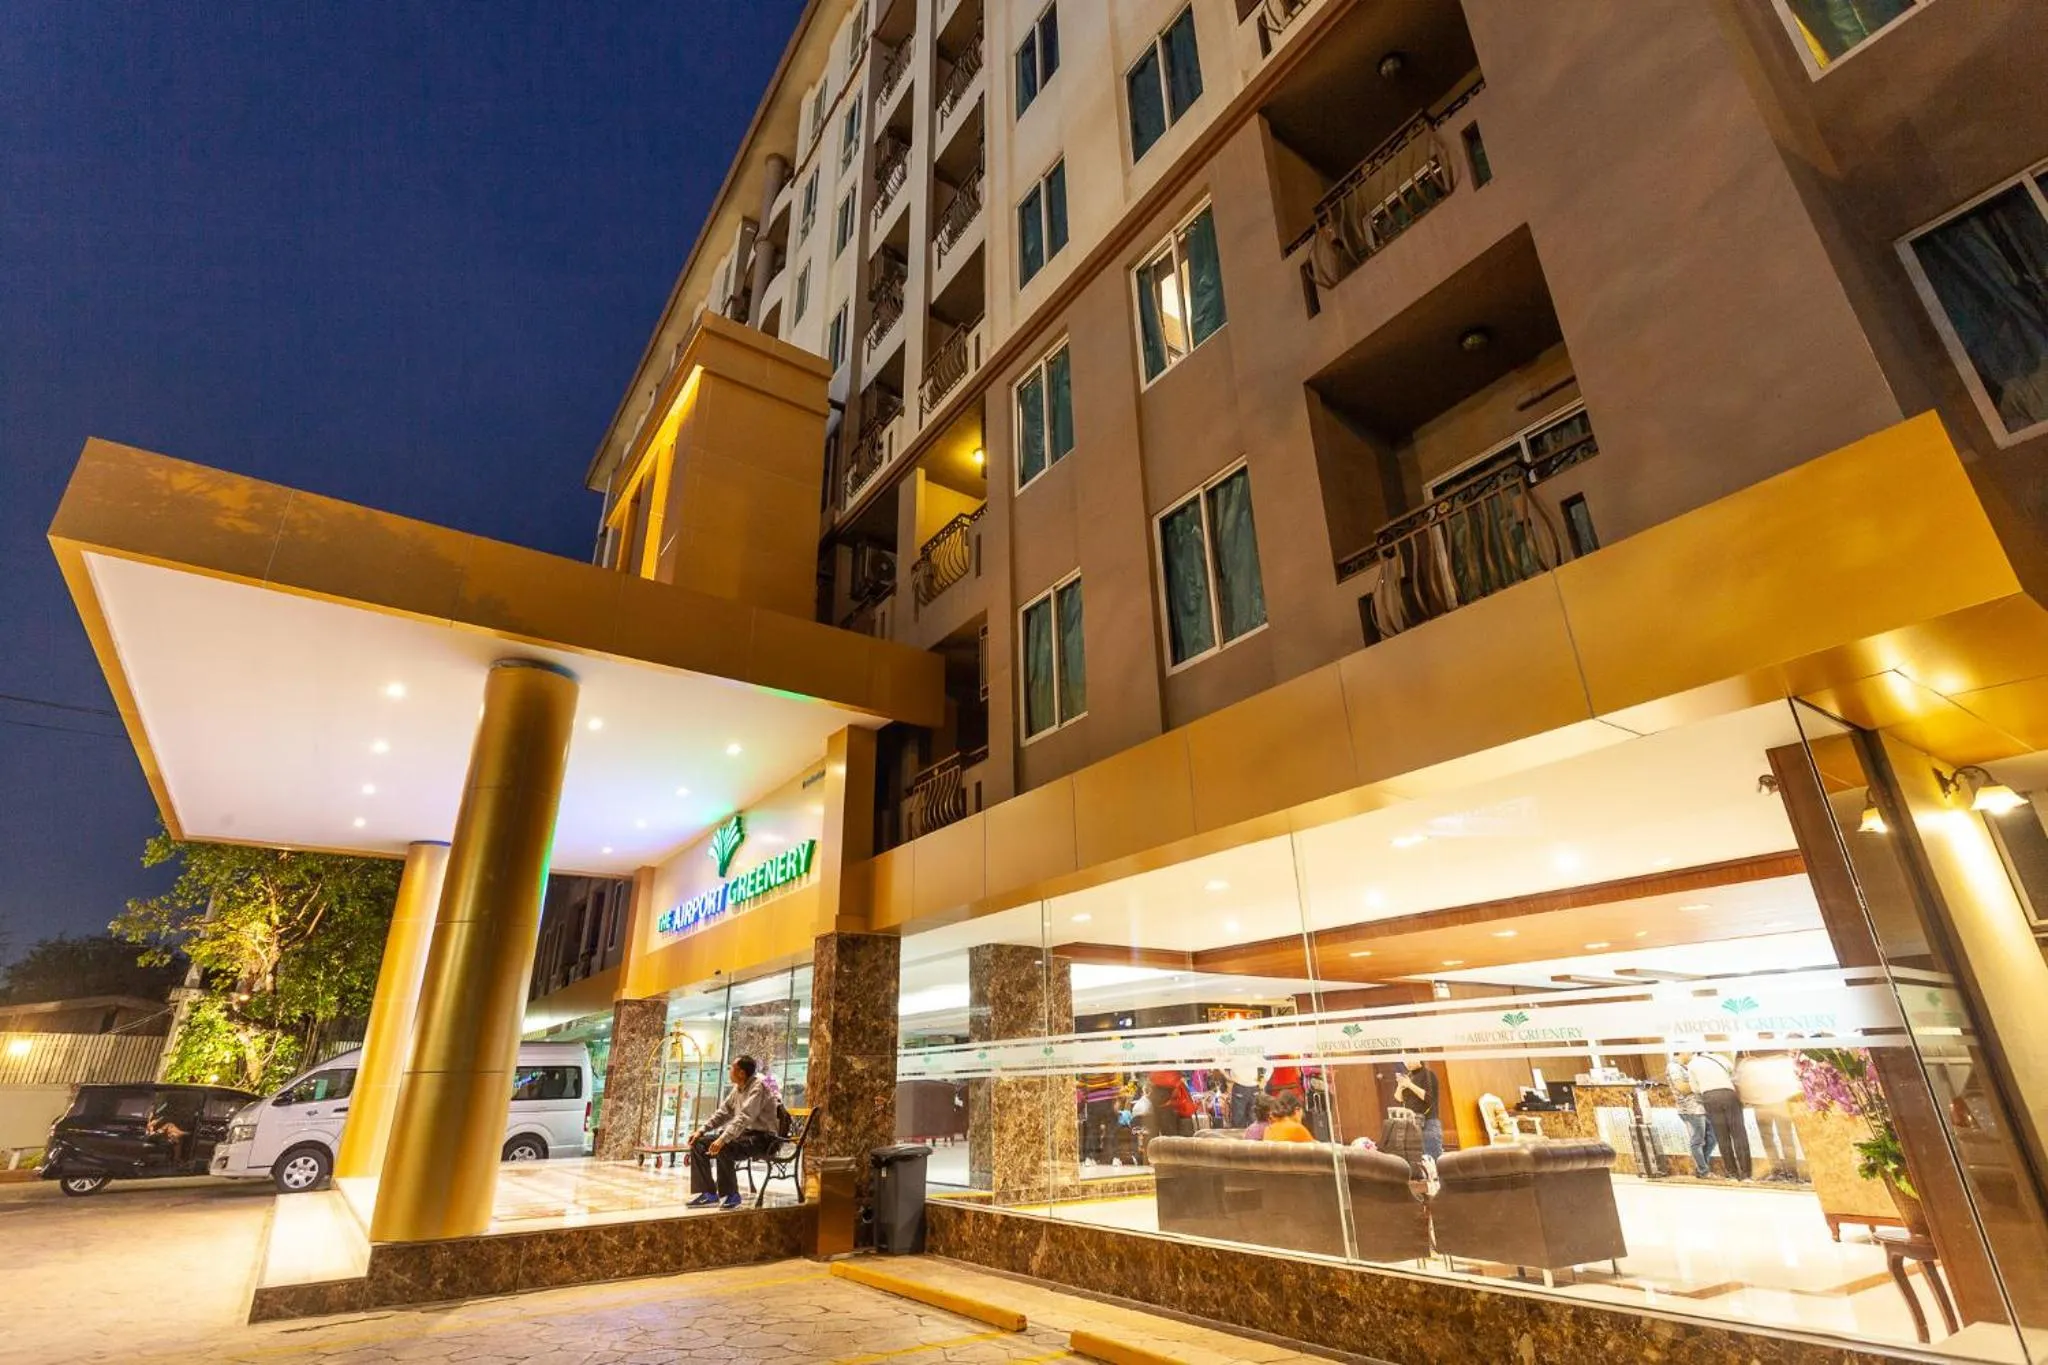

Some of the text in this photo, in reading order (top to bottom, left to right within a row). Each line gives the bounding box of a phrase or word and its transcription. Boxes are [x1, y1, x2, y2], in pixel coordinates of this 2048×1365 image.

[657, 839, 815, 932] THE AIRPORT GREENERY
[1673, 1017, 1740, 1034] AIRPORT
[1744, 1013, 1837, 1031] GREENERY
[1466, 1030, 1516, 1043] AIRPORT
